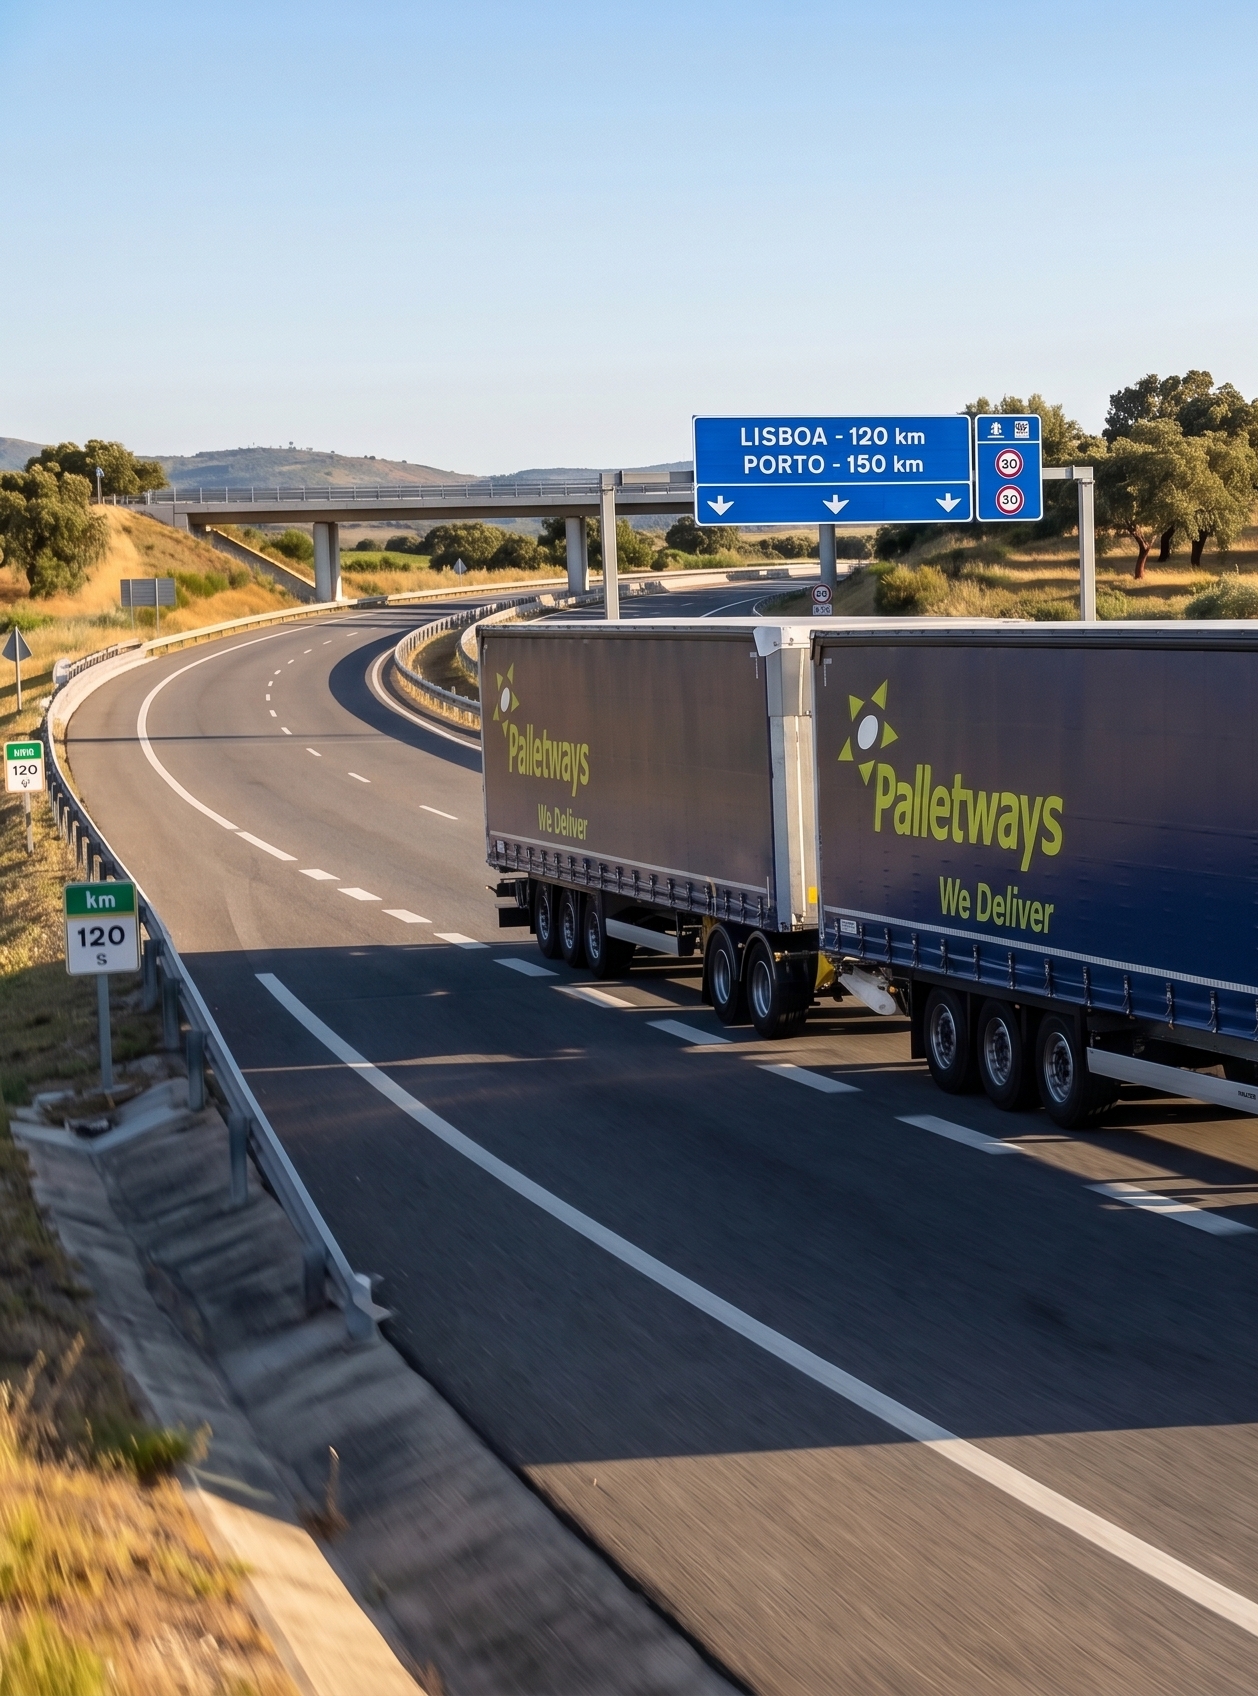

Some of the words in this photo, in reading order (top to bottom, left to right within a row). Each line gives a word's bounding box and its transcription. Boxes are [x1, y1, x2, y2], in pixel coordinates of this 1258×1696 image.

[741, 427, 828, 446] LISBOA
[849, 427, 888, 445] 120
[895, 427, 925, 445] km
[744, 455, 825, 474] PORTO
[847, 454, 886, 473] 150
[893, 455, 924, 473] km
[1001, 459, 1018, 469] 30
[1002, 495, 1018, 505] 30
[13, 765, 38, 776] 120
[509, 723, 590, 798] Palletways
[538, 804, 552, 832] We
[555, 807, 588, 840] Deliver
[875, 763, 1064, 872] Palletways
[86, 890, 116, 909] km
[940, 876, 970, 919] We
[977, 882, 1054, 933] Deliver
[78, 925, 125, 948] 120
